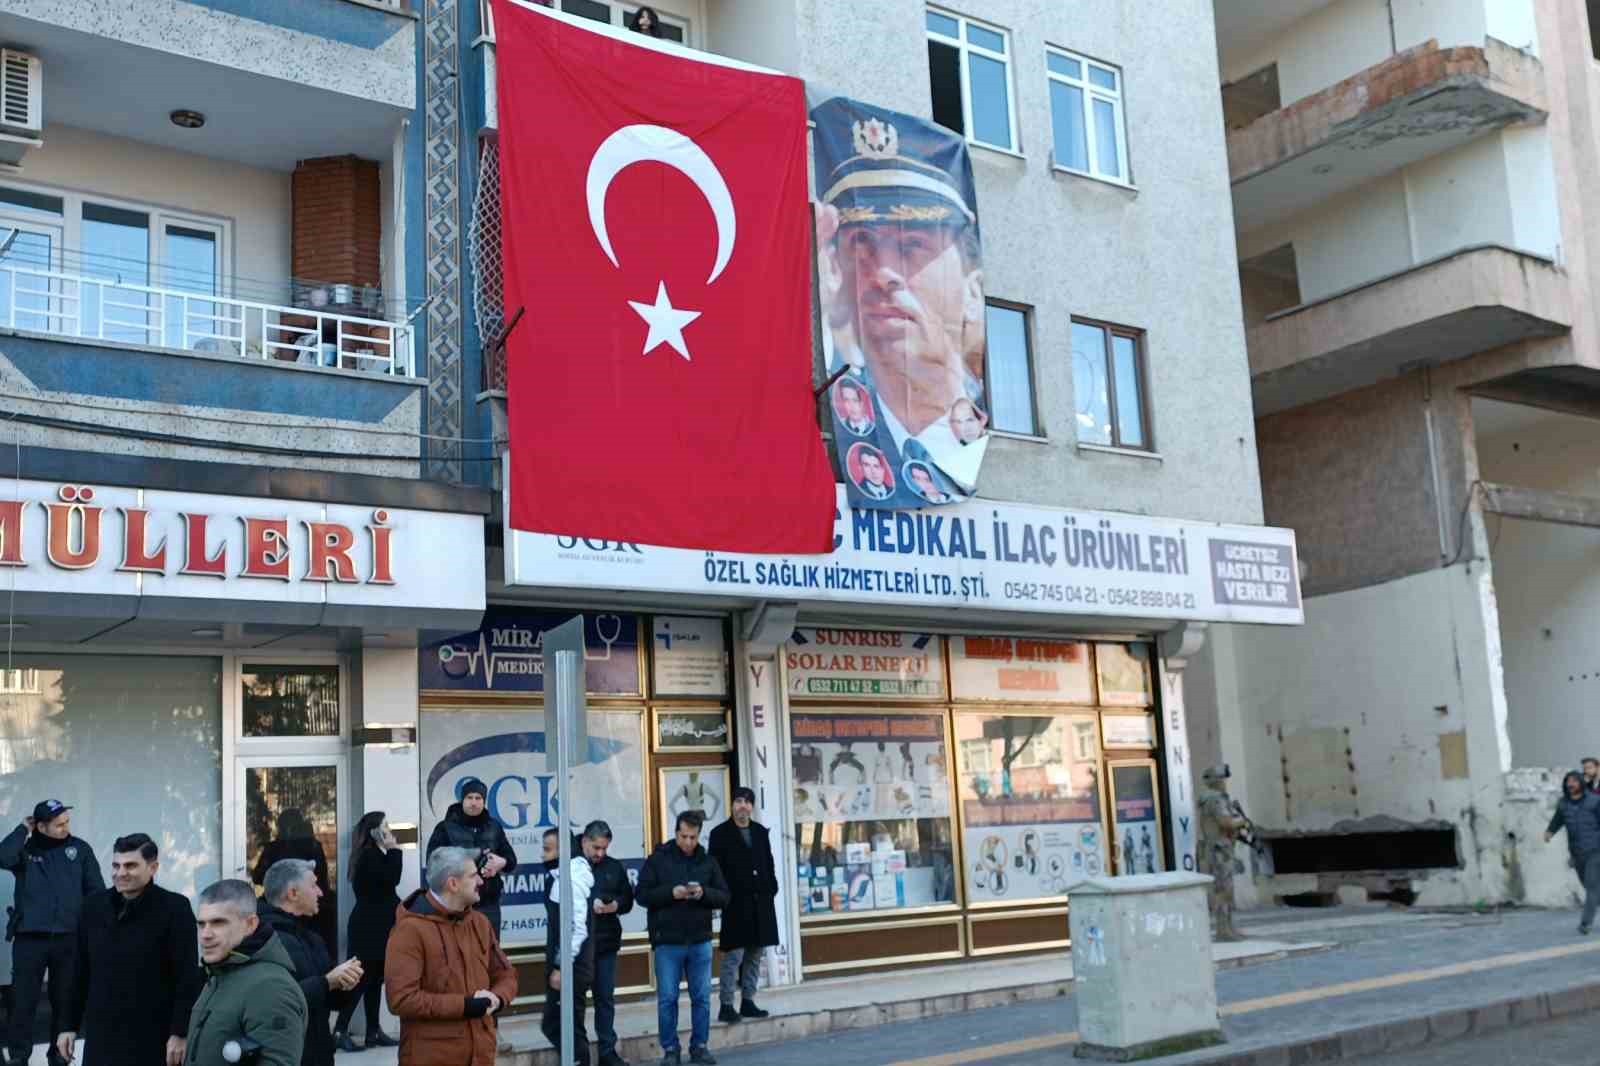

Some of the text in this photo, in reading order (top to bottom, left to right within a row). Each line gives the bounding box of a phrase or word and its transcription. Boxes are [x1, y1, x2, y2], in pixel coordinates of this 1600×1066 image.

[993, 509, 1057, 567] İLAÇ
[1063, 516, 1190, 575] ÜRÜNLERİ
[704, 552, 751, 584] ÖZEL
[756, 559, 820, 589] SAĞLIK
[824, 561, 920, 594] HİZMETLERİ
[923, 573, 957, 596] LTD.
[1004, 581, 1038, 600] 0542
[1040, 583, 1063, 602] 745
[1065, 585, 1083, 603] 04
[1084, 586, 1098, 604] 21
[1107, 588, 1139, 606] 0542
[786, 652, 858, 671] SOLAR
